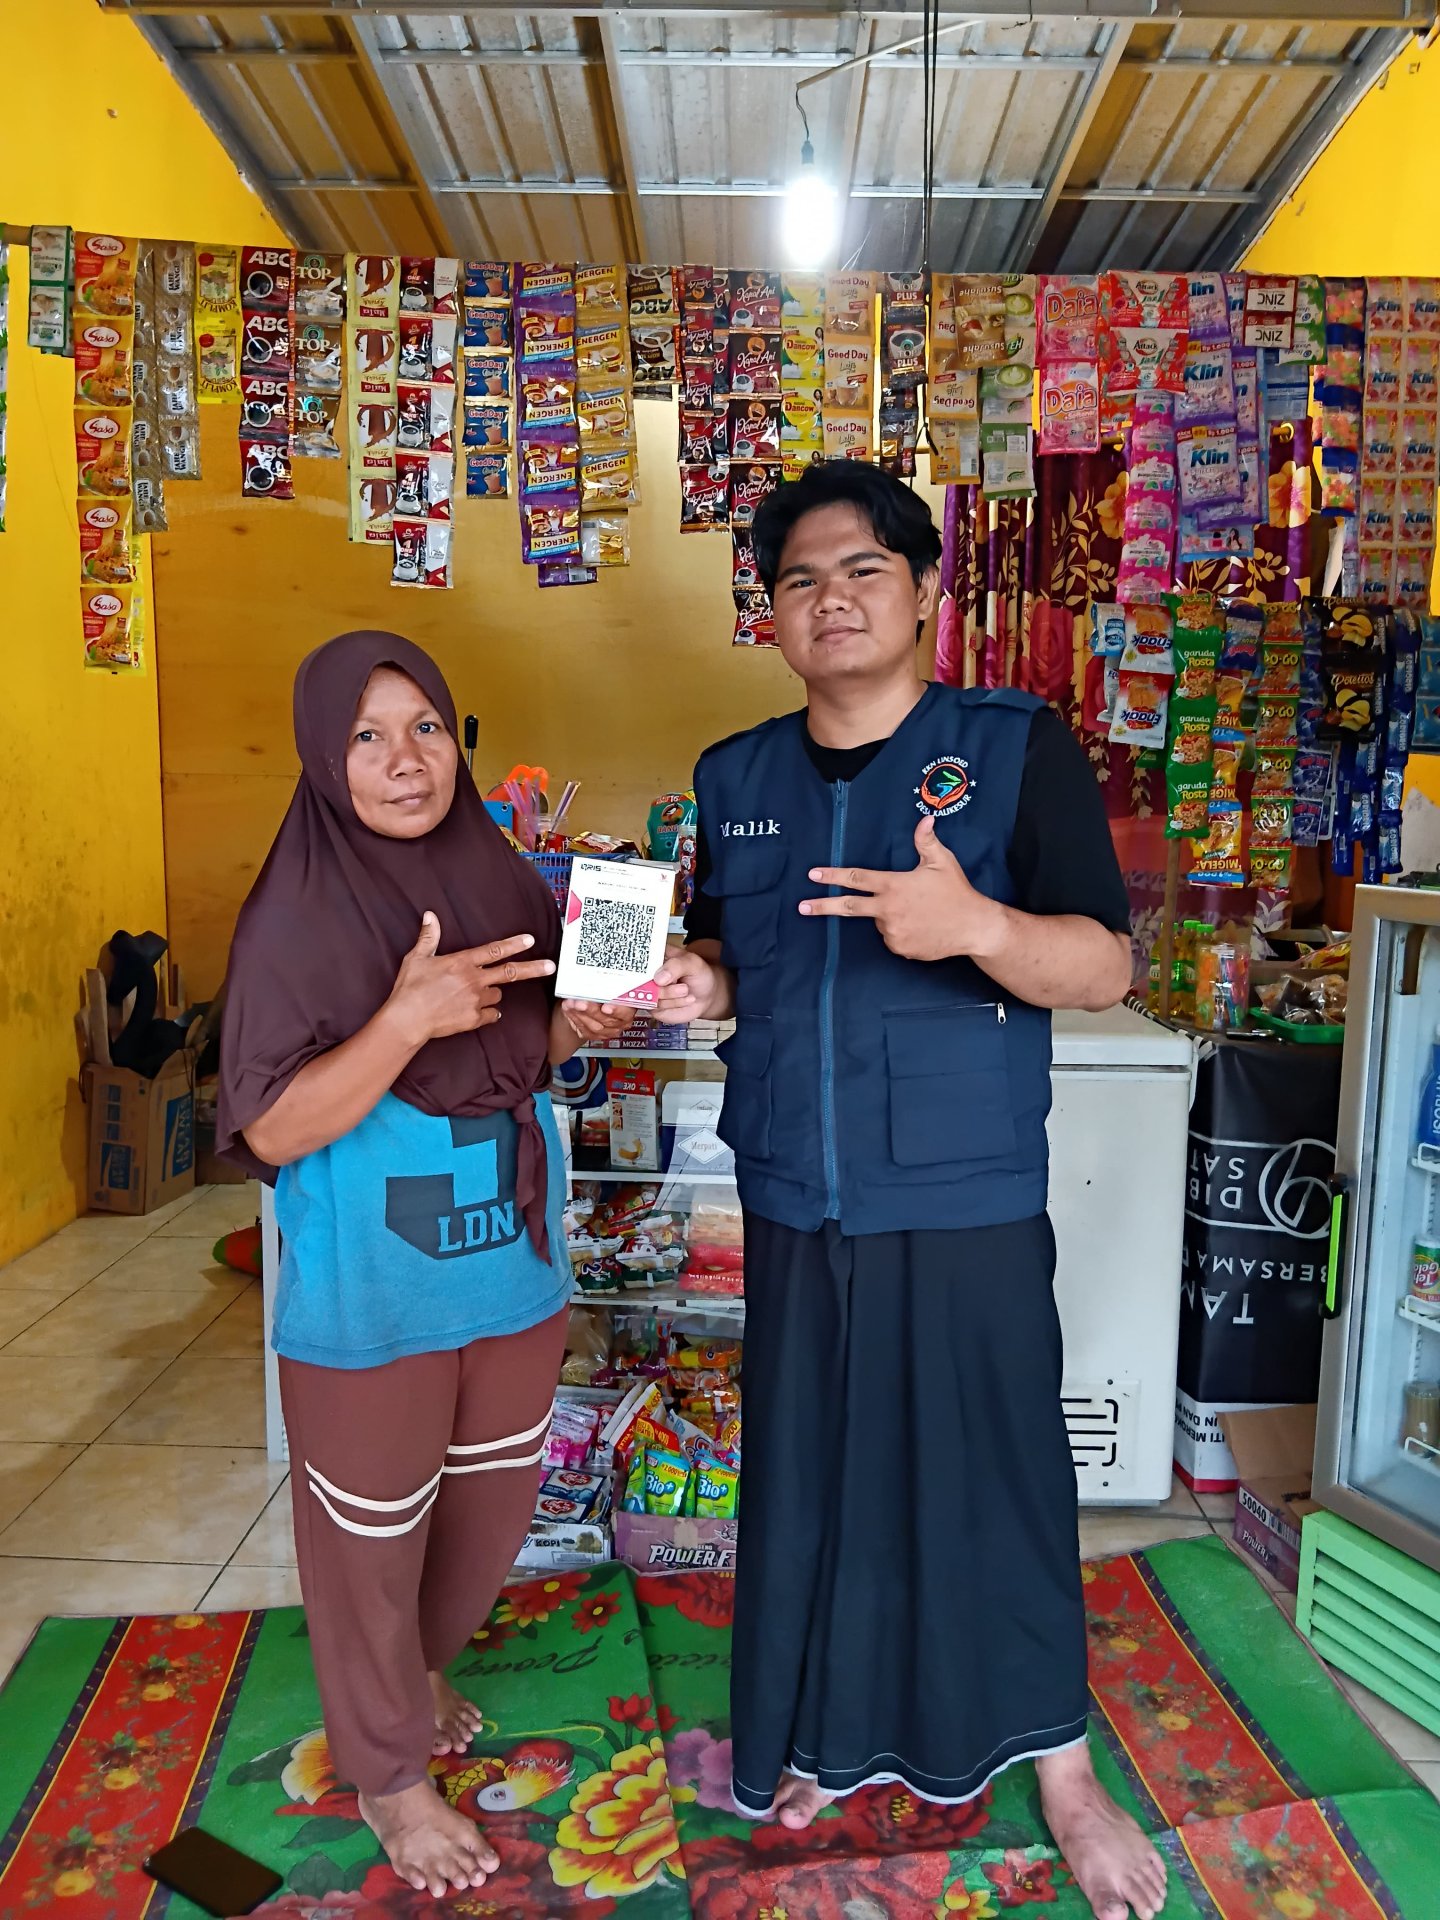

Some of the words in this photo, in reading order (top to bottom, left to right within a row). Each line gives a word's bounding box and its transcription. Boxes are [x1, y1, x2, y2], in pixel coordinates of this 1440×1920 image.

[91, 240, 119, 251] Sasa
[249, 251, 290, 267] ABC
[296, 267, 331, 280] TOP
[469, 262, 488, 270] Good
[489, 264, 504, 272] Day
[526, 275, 568, 287] ENERGEN
[853, 278, 869, 287] Day
[1135, 281, 1158, 292] Attack
[1189, 282, 1215, 296] lin
[896, 292, 917, 300] PLUS
[1257, 293, 1285, 306] ZINC
[631, 299, 672, 314] ABC
[1046, 290, 1097, 322] Daia
[1376, 298, 1400, 312] Klin
[1414, 298, 1438, 312] Klin
[469, 311, 488, 320] Good
[488, 312, 504, 321] Day
[246, 316, 288, 332] ABC
[88, 330, 116, 343] Sasa
[576, 331, 618, 345] ENERGEN
[1255, 330, 1283, 342] ZINC
[296, 338, 330, 352] TOP
[527, 342, 570, 352] ENERGEN
[787, 340, 816, 350] Dancow
[1134, 340, 1158, 351] Attack
[737, 352, 760, 368] Kapal
[760, 351, 776, 365] Api
[828, 349, 850, 359] Good
[852, 350, 868, 361] Day
[469, 360, 488, 368] Good
[488, 361, 503, 370] Day
[897, 358, 918, 367] PLUS
[1185, 364, 1223, 381] Klin
[1372, 371, 1396, 384] Klin
[1411, 371, 1434, 384] Klin
[246, 381, 288, 396] ABC
[934, 396, 954, 408] Day
[955, 396, 975, 408] Good
[1045, 384, 1097, 416] Daia
[529, 407, 571, 418] ENERGEN
[786, 402, 814, 412] Dancow
[297, 409, 328, 424] TOP
[469, 410, 487, 418] Good
[487, 411, 503, 420] Day
[89, 420, 114, 435] Sasa
[826, 423, 848, 432] Good
[850, 424, 866, 434] Day
[1370, 441, 1393, 454] Klin
[1407, 441, 1432, 455] Klin
[470, 458, 487, 467] Good
[487, 460, 502, 468] Day
[1191, 449, 1229, 467] Klin
[585, 459, 626, 474] ENERGEN
[531, 472, 572, 484] ENERGEN
[90, 510, 115, 524] Sasa
[1366, 510, 1389, 524] Klin
[1405, 510, 1429, 524] Klin
[534, 536, 575, 548] ENERGEN
[1363, 580, 1386, 594] Klin
[1401, 580, 1425, 594] Klin
[94, 597, 117, 612] Sasa
[1131, 634, 1173, 650] Enaak
[1184, 650, 1215, 658] garuda
[1189, 658, 1215, 666] Rosta
[1121, 711, 1162, 723] Enaak
[1179, 716, 1211, 724] garuda
[1184, 723, 1210, 733] Rosta
[922, 760, 936, 775] KKN
[937, 756, 968, 768] UNSOED
[1177, 782, 1208, 791] garuda
[1182, 790, 1208, 800] Rosta
[933, 794, 972, 817] KALIKESUR
[720, 819, 781, 840] Malik
[581, 863, 601, 872] QRIS
[623, 1030, 645, 1038] MOZZA
[438, 1200, 516, 1252] LDN
[1414, 1273, 1433, 1286] Teh
[697, 1475, 728, 1498] Bio+
[1242, 1493, 1266, 1523] 50040
[535, 1538, 560, 1547] KOPI
[1243, 1530, 1265, 1557] POWER
[649, 1544, 715, 1565] POWER
